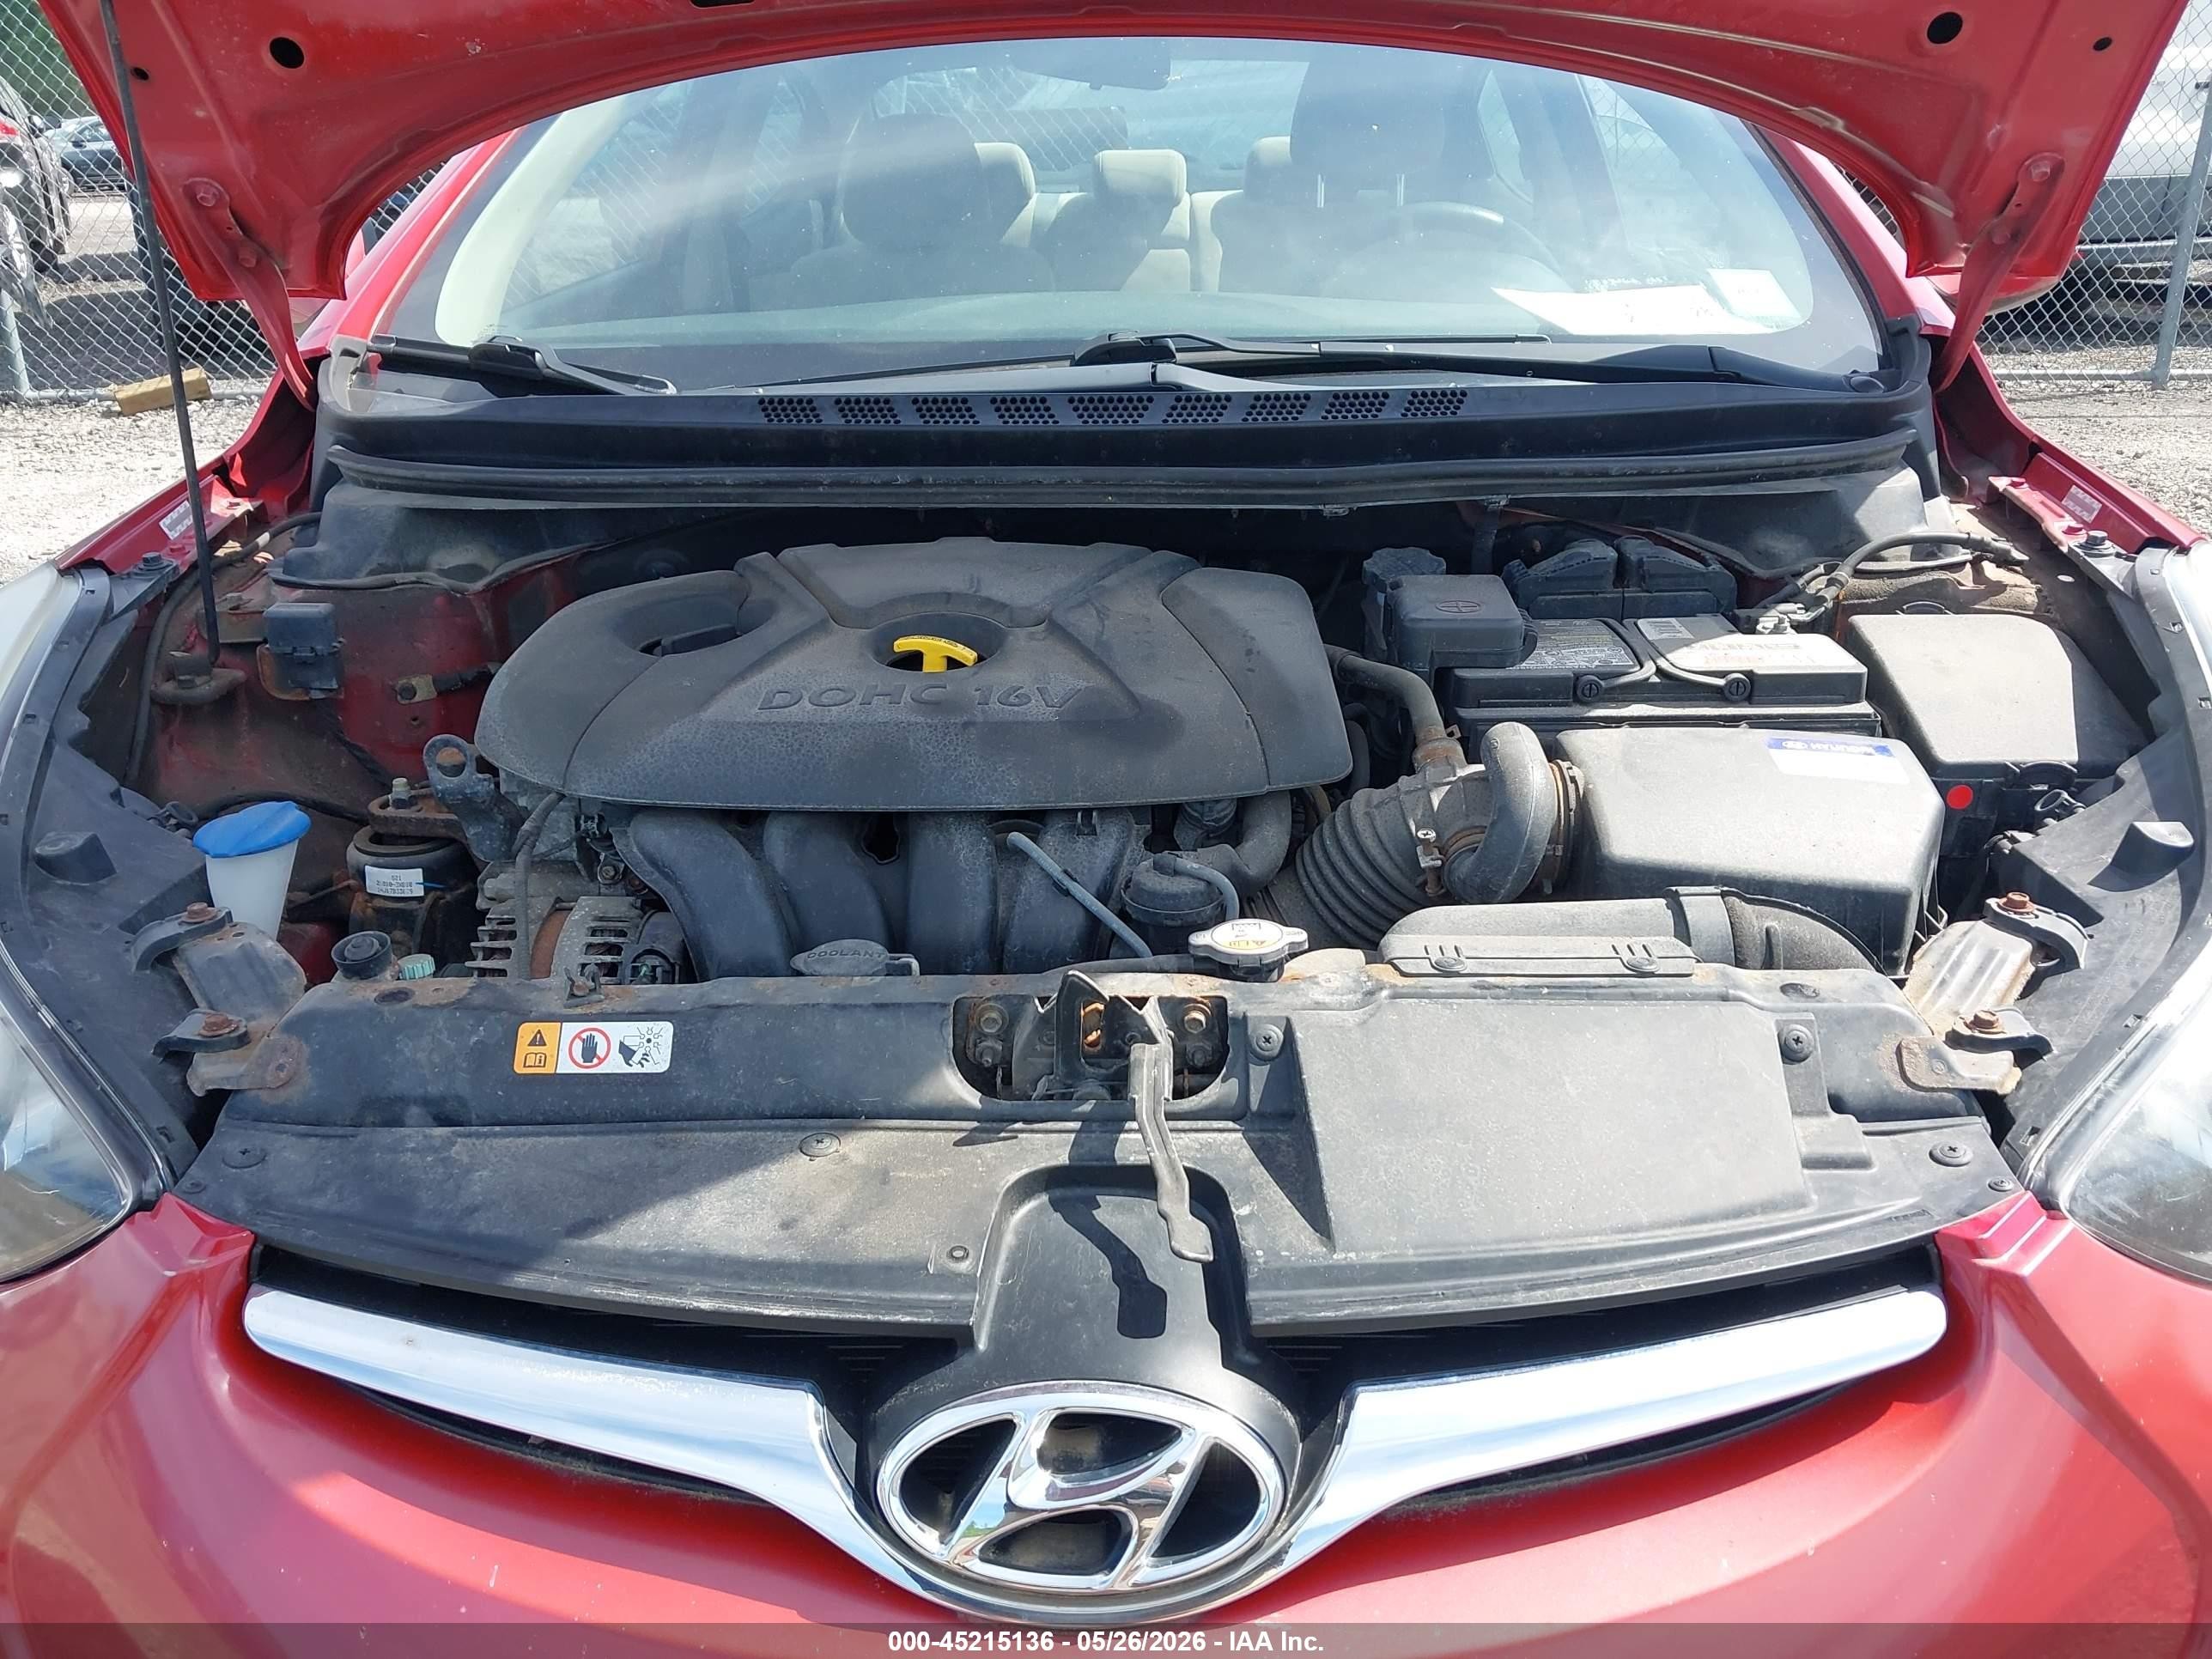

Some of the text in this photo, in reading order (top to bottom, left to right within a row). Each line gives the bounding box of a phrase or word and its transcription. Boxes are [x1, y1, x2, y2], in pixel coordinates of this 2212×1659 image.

[757, 683, 1087, 710] DOHC 16V
[807, 948, 886, 959] COOLANT
